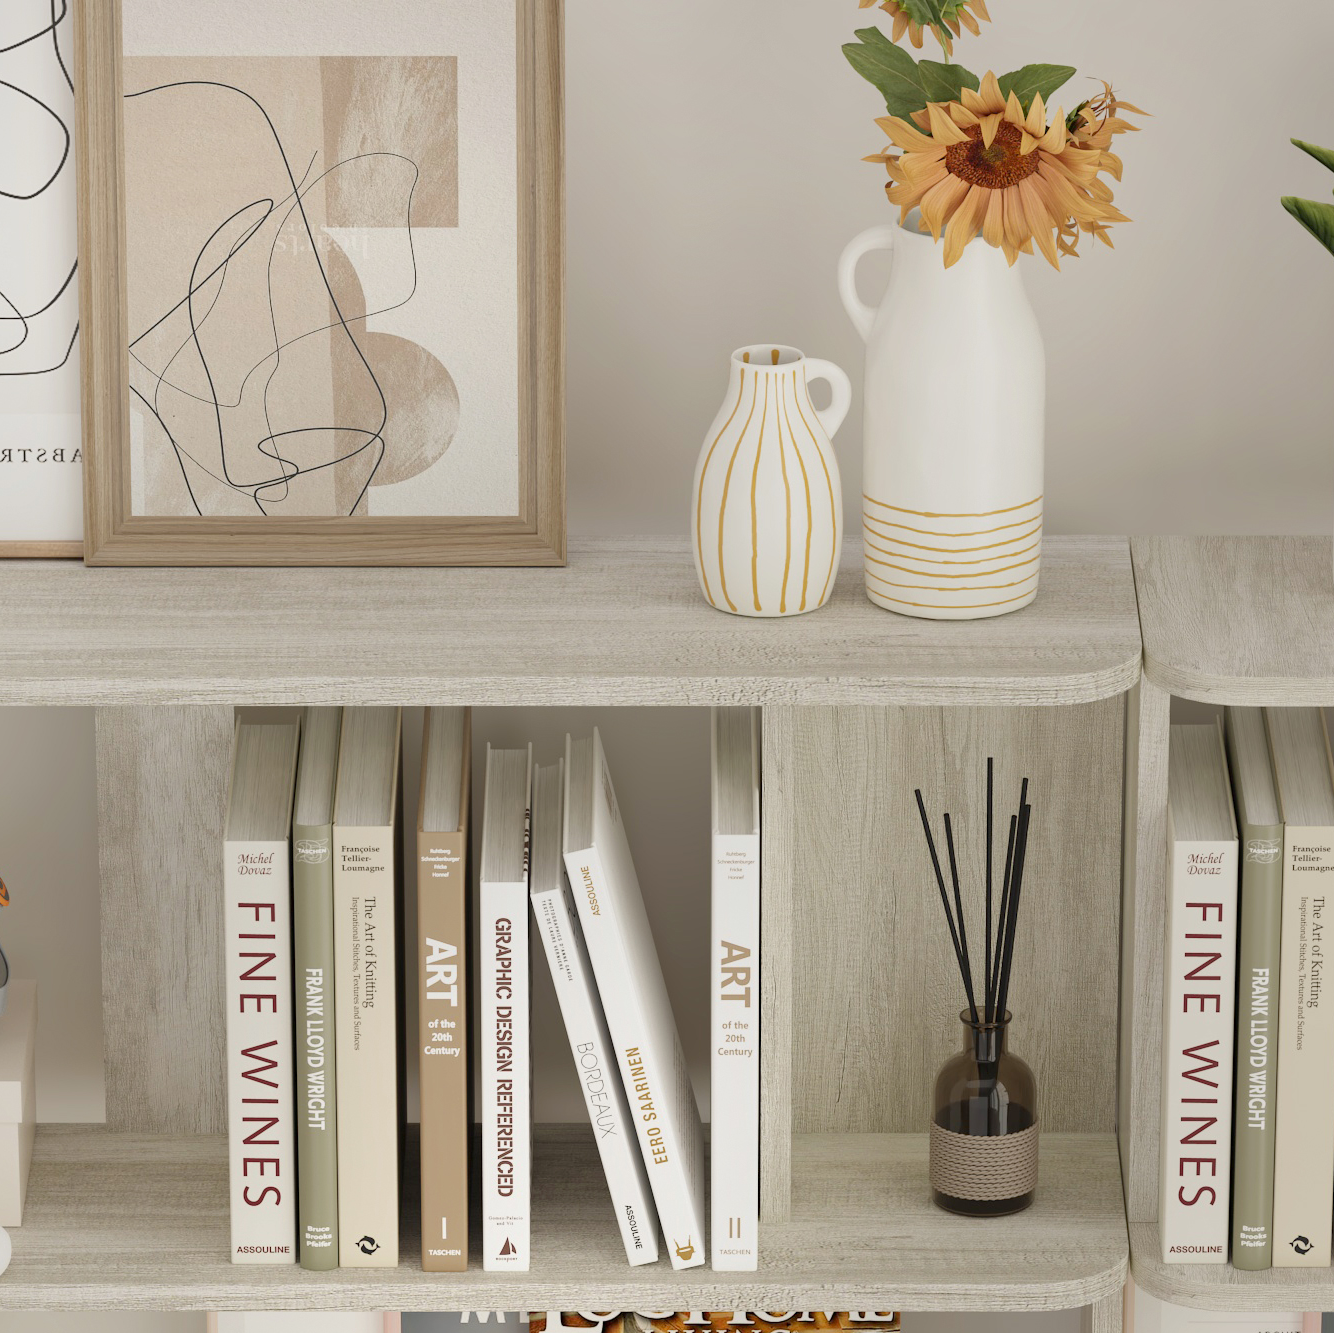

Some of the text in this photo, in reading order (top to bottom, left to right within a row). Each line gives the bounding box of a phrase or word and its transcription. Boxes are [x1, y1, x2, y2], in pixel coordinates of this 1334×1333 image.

[237, 864, 272, 876] Dovaz
[238, 853, 273, 864] Michel
[341, 845, 380, 855] Françoise
[341, 864, 385, 873] Loumagne
[580, 866, 601, 916] ASSOULINE
[350, 896, 360, 942] Inspirational
[362, 896, 378, 1009] The Art of Knitting
[425, 937, 458, 1007] ART
[721, 940, 751, 1008] ART
[352, 974, 361, 1005] Textures
[353, 1006, 361, 1020] and
[353, 1021, 361, 1051] Surfaces
[428, 1019, 456, 1029] of the
[238, 903, 281, 1206] FINE WINES
[305, 968, 325, 1130] FRANK LLOYD WRIGHT
[424, 1046, 460, 1057] Century
[431, 1032, 453, 1042] 20th
[495, 918, 514, 1197] GRAPHIC DESIGN REFERENCED
[718, 1048, 753, 1057] Century
[725, 1034, 746, 1043] 20th
[1178, 902, 1223, 1207] FINE WINES
[1247, 967, 1270, 1130] FRANK LLOYD WRIGHT
[576, 1042, 617, 1139] BORDEAUX
[625, 1047, 668, 1165] EERO SAARINEN
[625, 1204, 643, 1250] ASSOULINE
